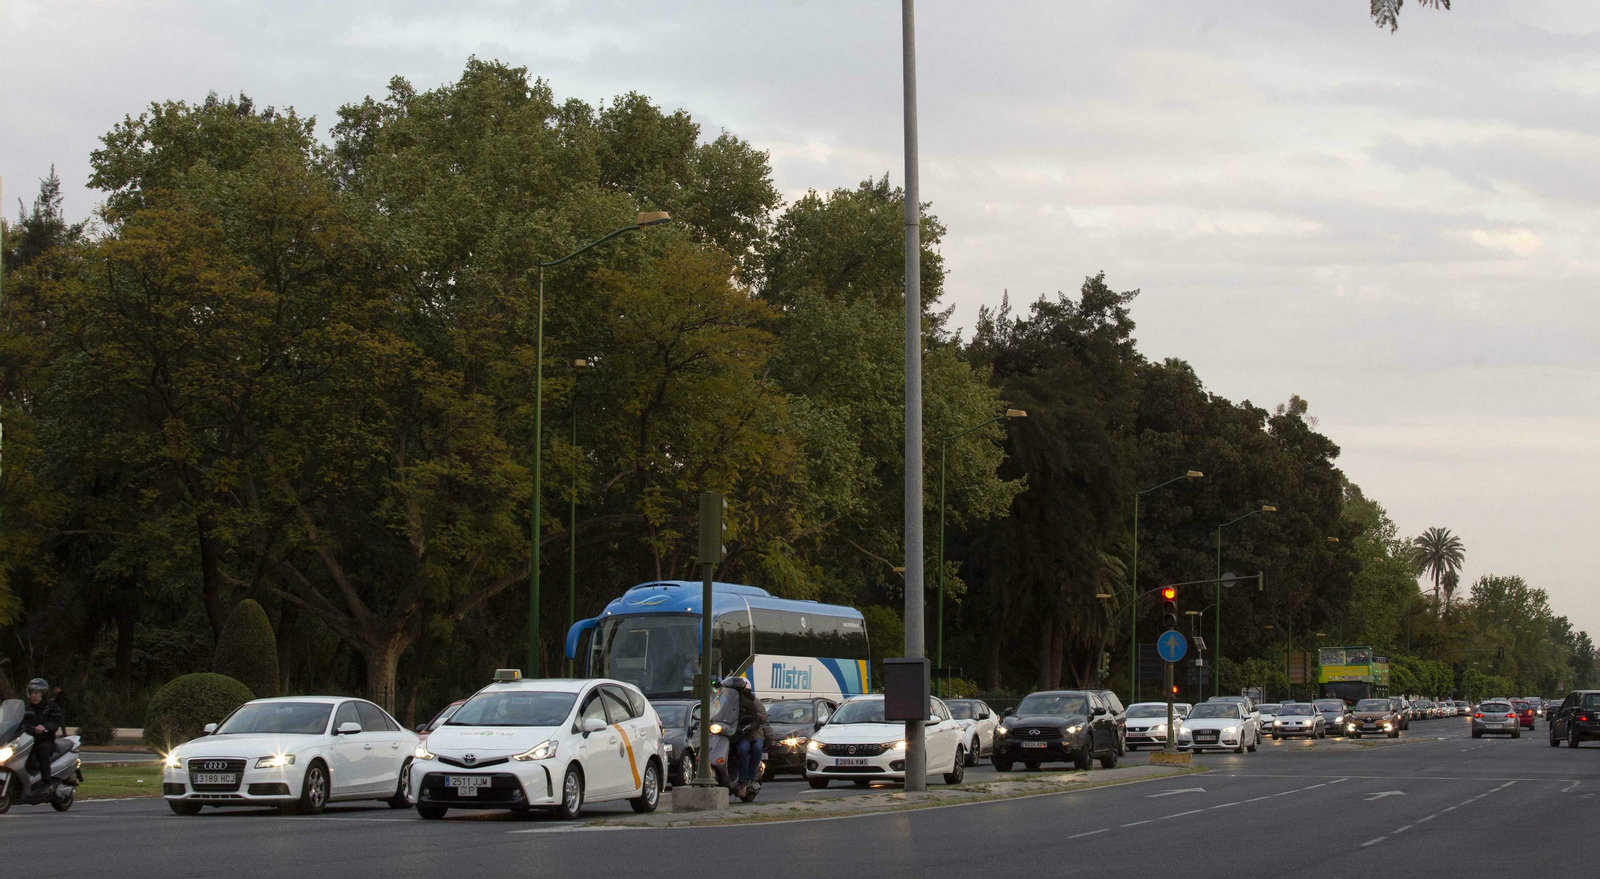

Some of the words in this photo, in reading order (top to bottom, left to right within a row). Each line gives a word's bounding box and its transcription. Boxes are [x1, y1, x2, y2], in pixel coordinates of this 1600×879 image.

[771, 662, 812, 690] Mistral
[199, 774, 218, 783] 3189
[220, 774, 235, 783] HCJ
[452, 777, 471, 786] 2511
[473, 777, 488, 786] JJM
